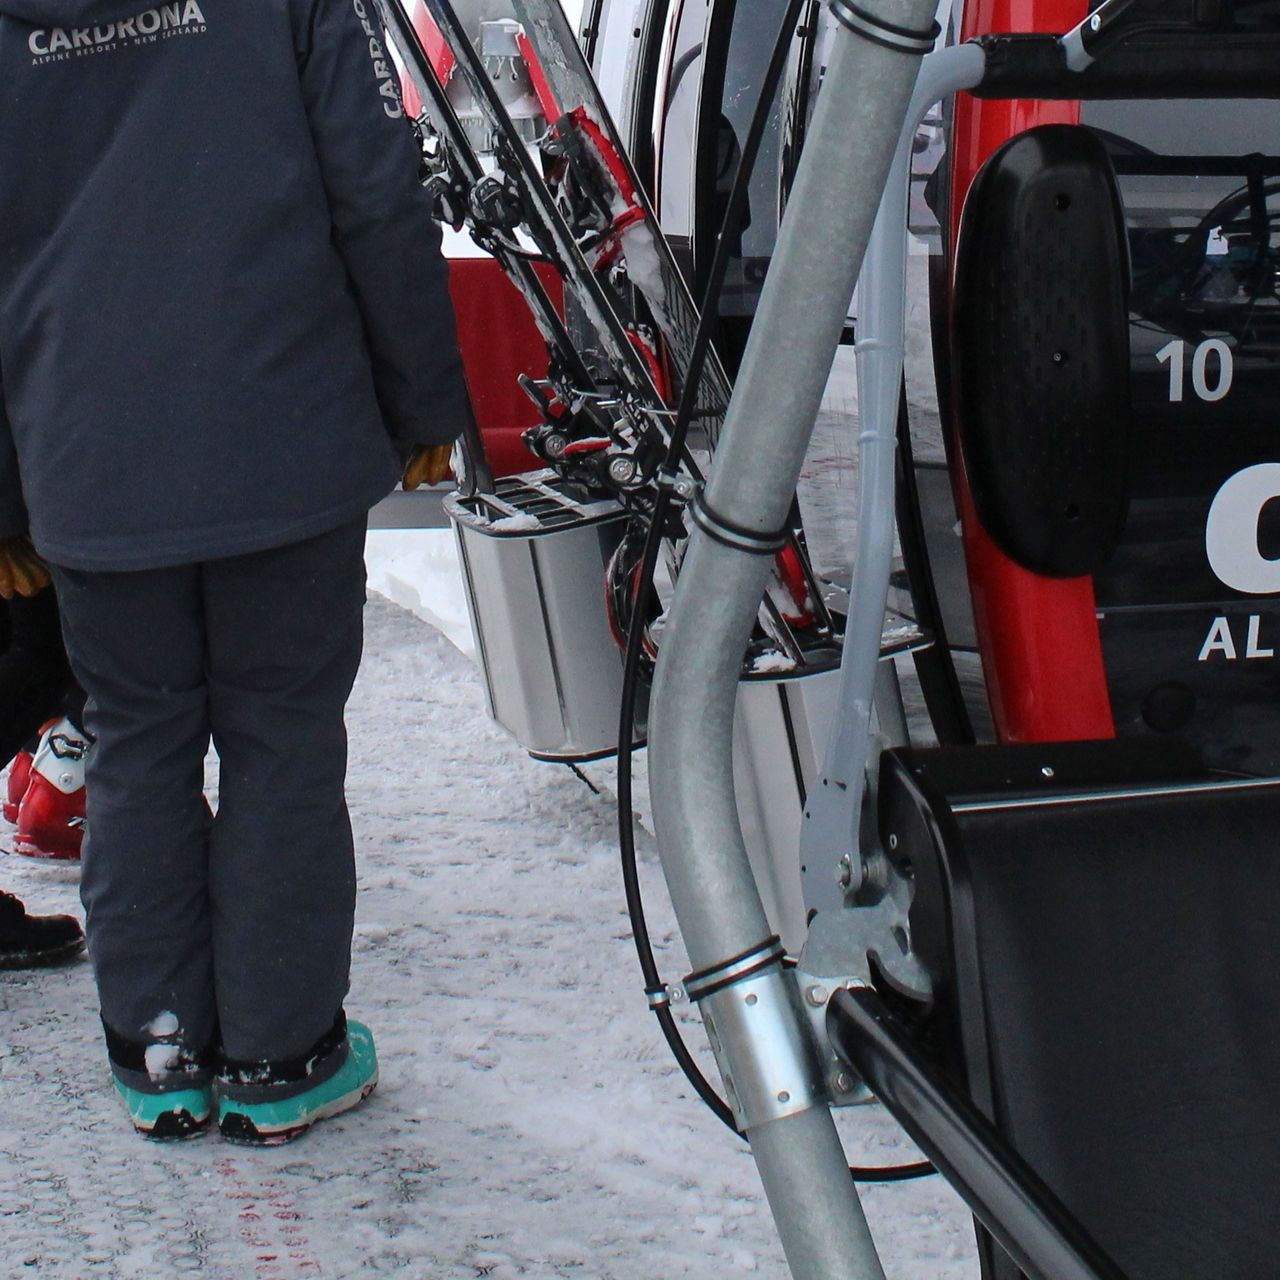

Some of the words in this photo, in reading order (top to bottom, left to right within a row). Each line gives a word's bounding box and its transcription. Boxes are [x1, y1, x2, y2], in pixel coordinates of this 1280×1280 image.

[29, 0, 206, 56] CARDRONA
[32, 51, 70, 65] ALPINE
[76, 42, 117, 57] RESORT
[134, 34, 157, 45] NEW
[1155, 338, 1233, 402] 10
